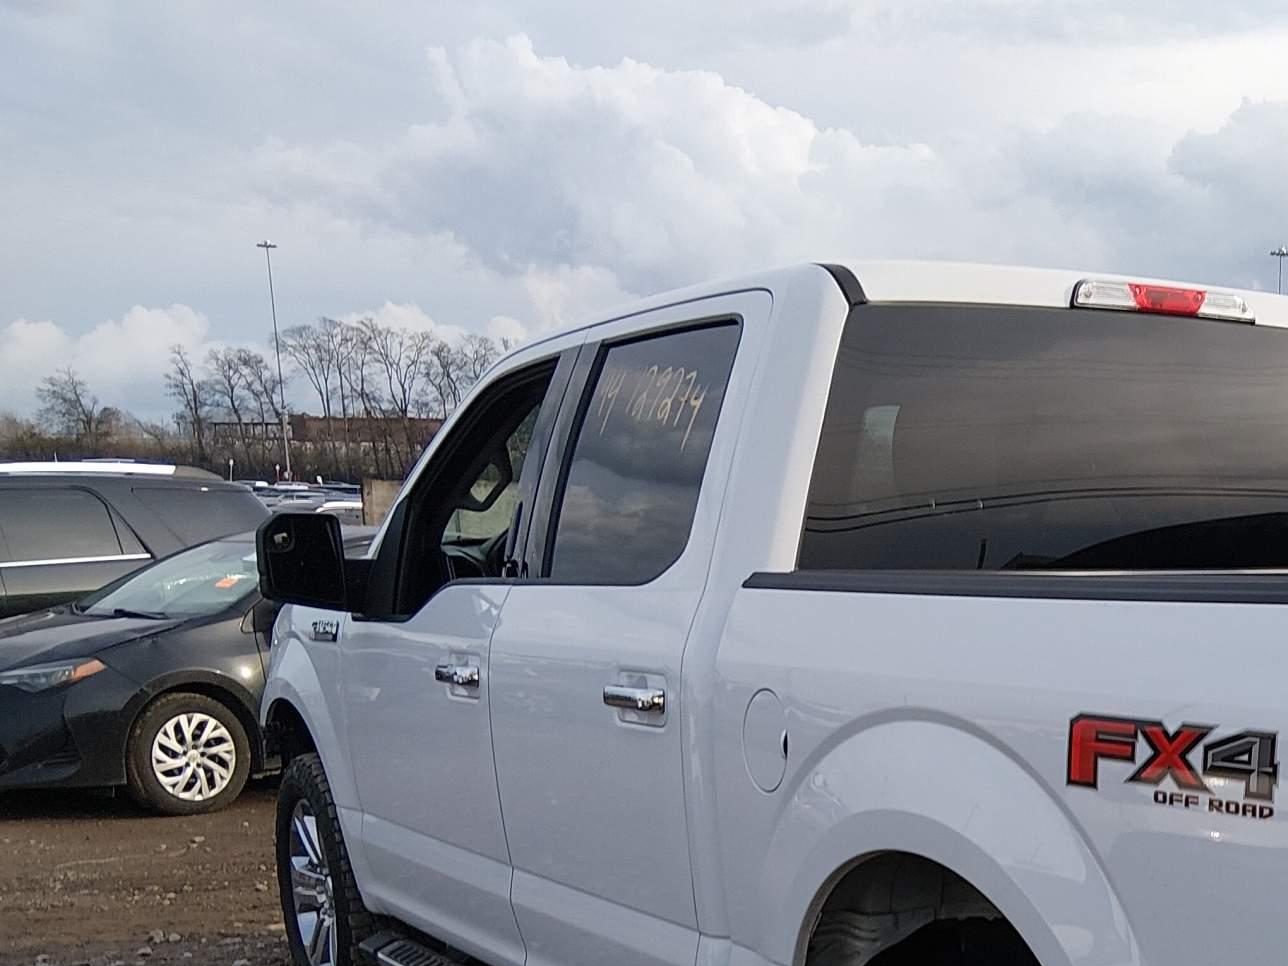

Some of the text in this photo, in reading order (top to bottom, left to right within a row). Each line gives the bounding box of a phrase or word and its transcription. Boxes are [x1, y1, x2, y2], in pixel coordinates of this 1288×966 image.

[1066, 711, 1279, 803] FX4
[1153, 791, 1274, 819] OFF ROAD
